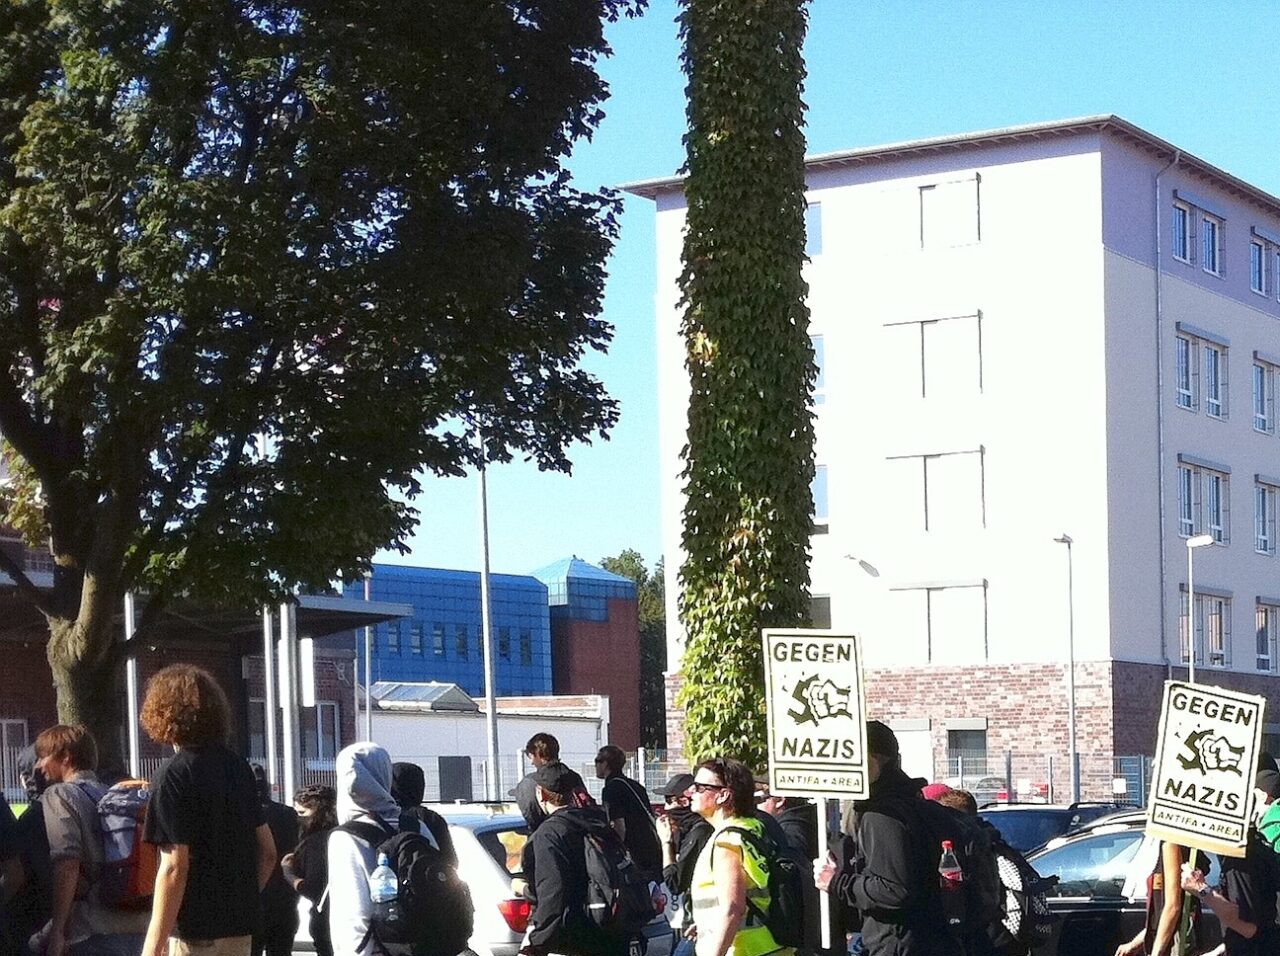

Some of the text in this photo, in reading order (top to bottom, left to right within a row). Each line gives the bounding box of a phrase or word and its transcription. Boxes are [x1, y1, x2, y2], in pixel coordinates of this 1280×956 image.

[773, 642, 851, 663] GEGEN
[1173, 693, 1252, 726] GEGEN
[782, 737, 855, 759] NAZIS
[779, 775, 860, 787] ANTIFA AREA
[1164, 778, 1240, 811] NAZIS
[1157, 811, 1240, 837] ANTIFA AREA
